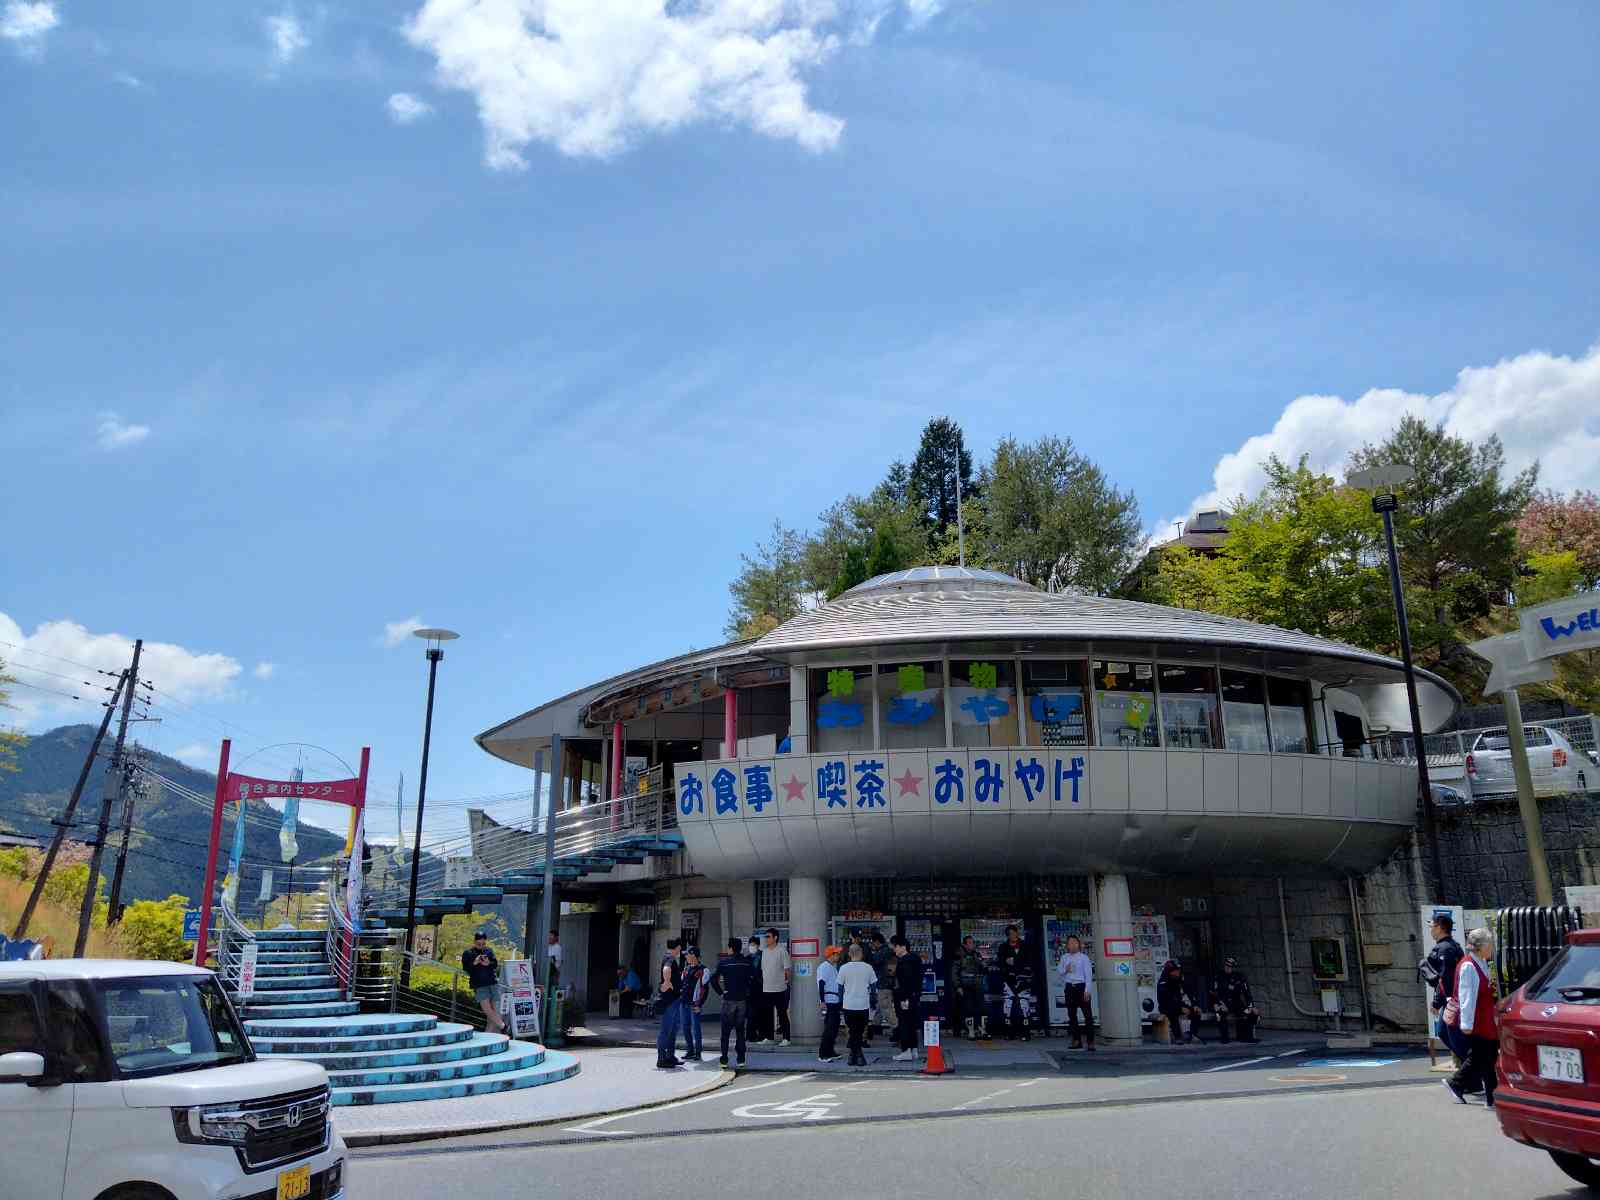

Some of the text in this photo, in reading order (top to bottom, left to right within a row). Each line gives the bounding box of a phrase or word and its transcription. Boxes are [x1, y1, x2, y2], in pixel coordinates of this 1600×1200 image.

[679, 756, 1084, 816] お食事 喫茶 おみやげ
